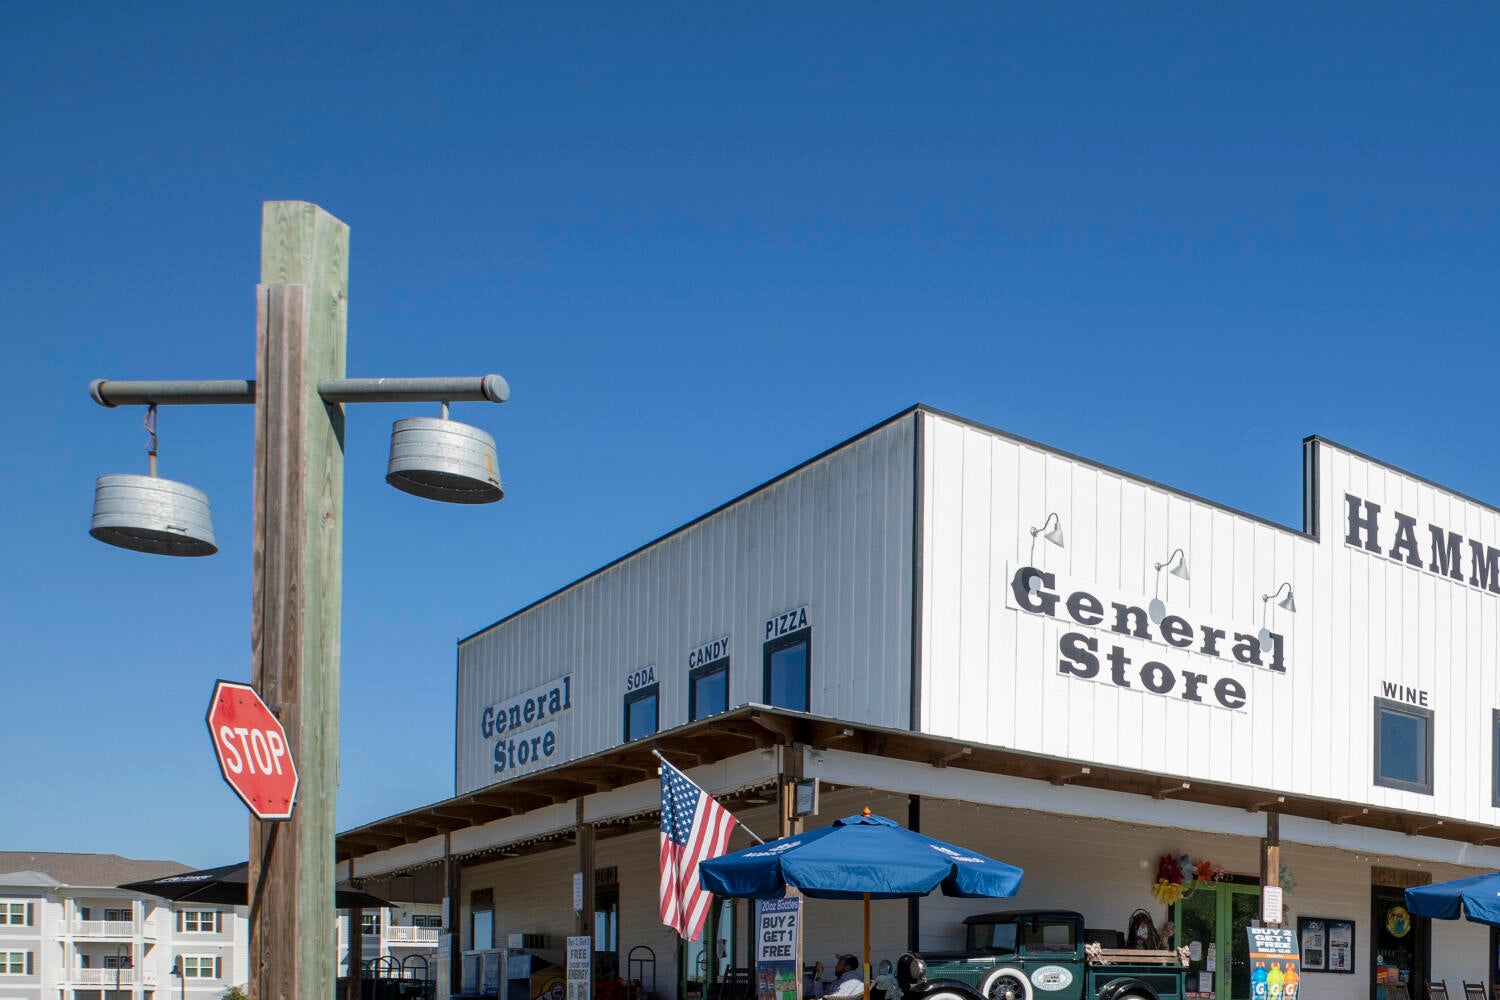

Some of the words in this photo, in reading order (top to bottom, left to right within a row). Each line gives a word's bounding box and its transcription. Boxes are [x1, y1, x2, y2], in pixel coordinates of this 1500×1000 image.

[765, 607, 808, 639] PIZZA
[1010, 566, 1287, 673] General
[689, 637, 729, 668] CANDY
[627, 667, 655, 691] SODA
[1058, 631, 1247, 709] Store
[1382, 681, 1429, 707] WINE
[481, 676, 572, 739] General
[220, 725, 285, 776] STOP
[494, 730, 556, 774] Store
[762, 916, 786, 929] BUY
[787, 915, 796, 927] 2
[763, 930, 787, 943] GET
[788, 930, 793, 941] 1
[1254, 934, 1283, 942] GET
[1256, 941, 1292, 949] FREE
[570, 948, 587, 959] FREE
[763, 945, 791, 958] FREE
[568, 969, 588, 980] ENERGY
